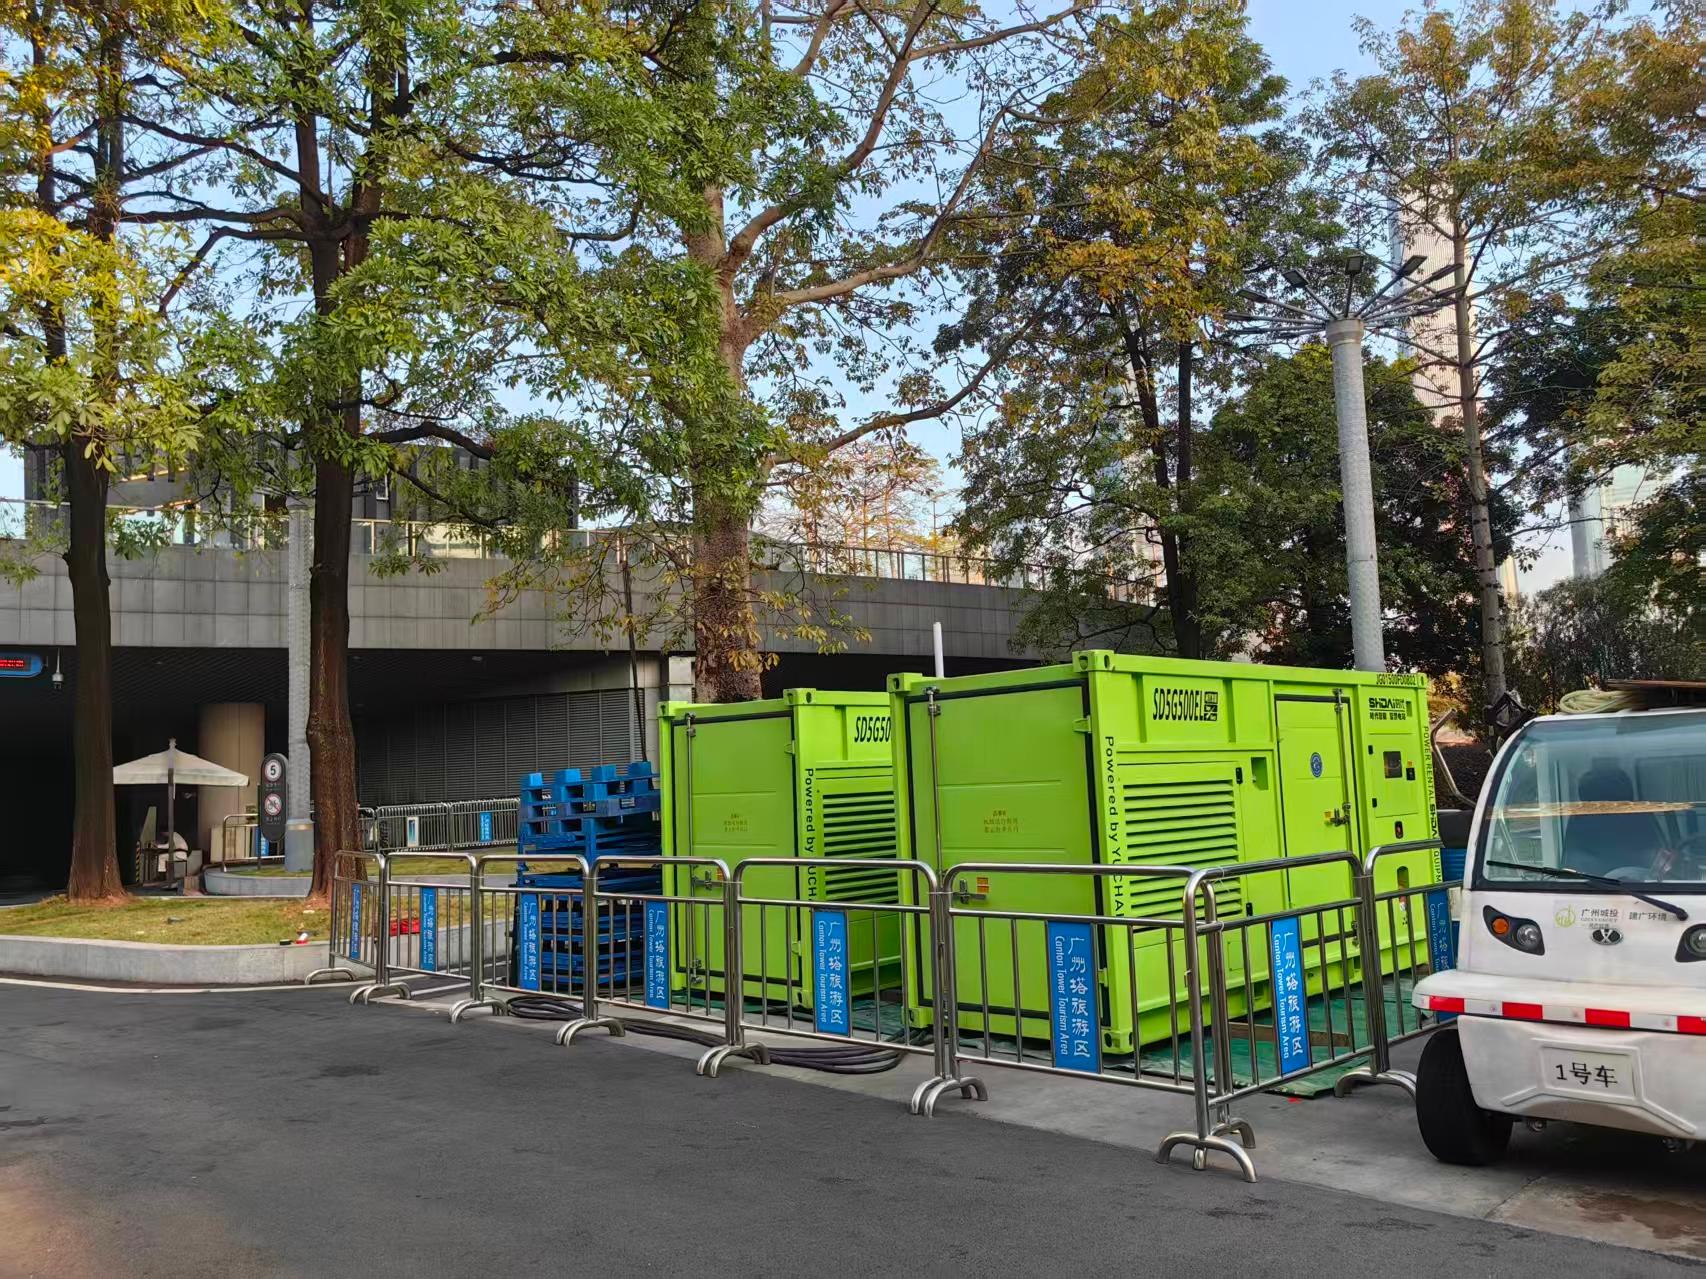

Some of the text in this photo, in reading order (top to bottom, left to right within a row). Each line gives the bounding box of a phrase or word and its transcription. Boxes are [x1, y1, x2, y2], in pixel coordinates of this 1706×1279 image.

[1152, 688, 1204, 721] SD5G500EL
[854, 716, 891, 742] SD5G50
[270, 765, 276, 776] 5
[1104, 736, 1118, 816] Powered
[1426, 763, 1434, 802] RENTAL
[804, 768, 815, 832] Powered
[804, 838, 816, 853] by
[1108, 822, 1119, 842] by
[1582, 909, 1618, 918] 广州城投
[828, 921, 843, 1024] 广州塔旅游区
[1055, 936, 1069, 1055] Canton Tower Tourism Area
[1068, 937, 1090, 1058] 广州塔旅游区
[1283, 932, 1303, 1056] 广州塔旅游区
[1556, 1062, 1618, 1088] 1号车
